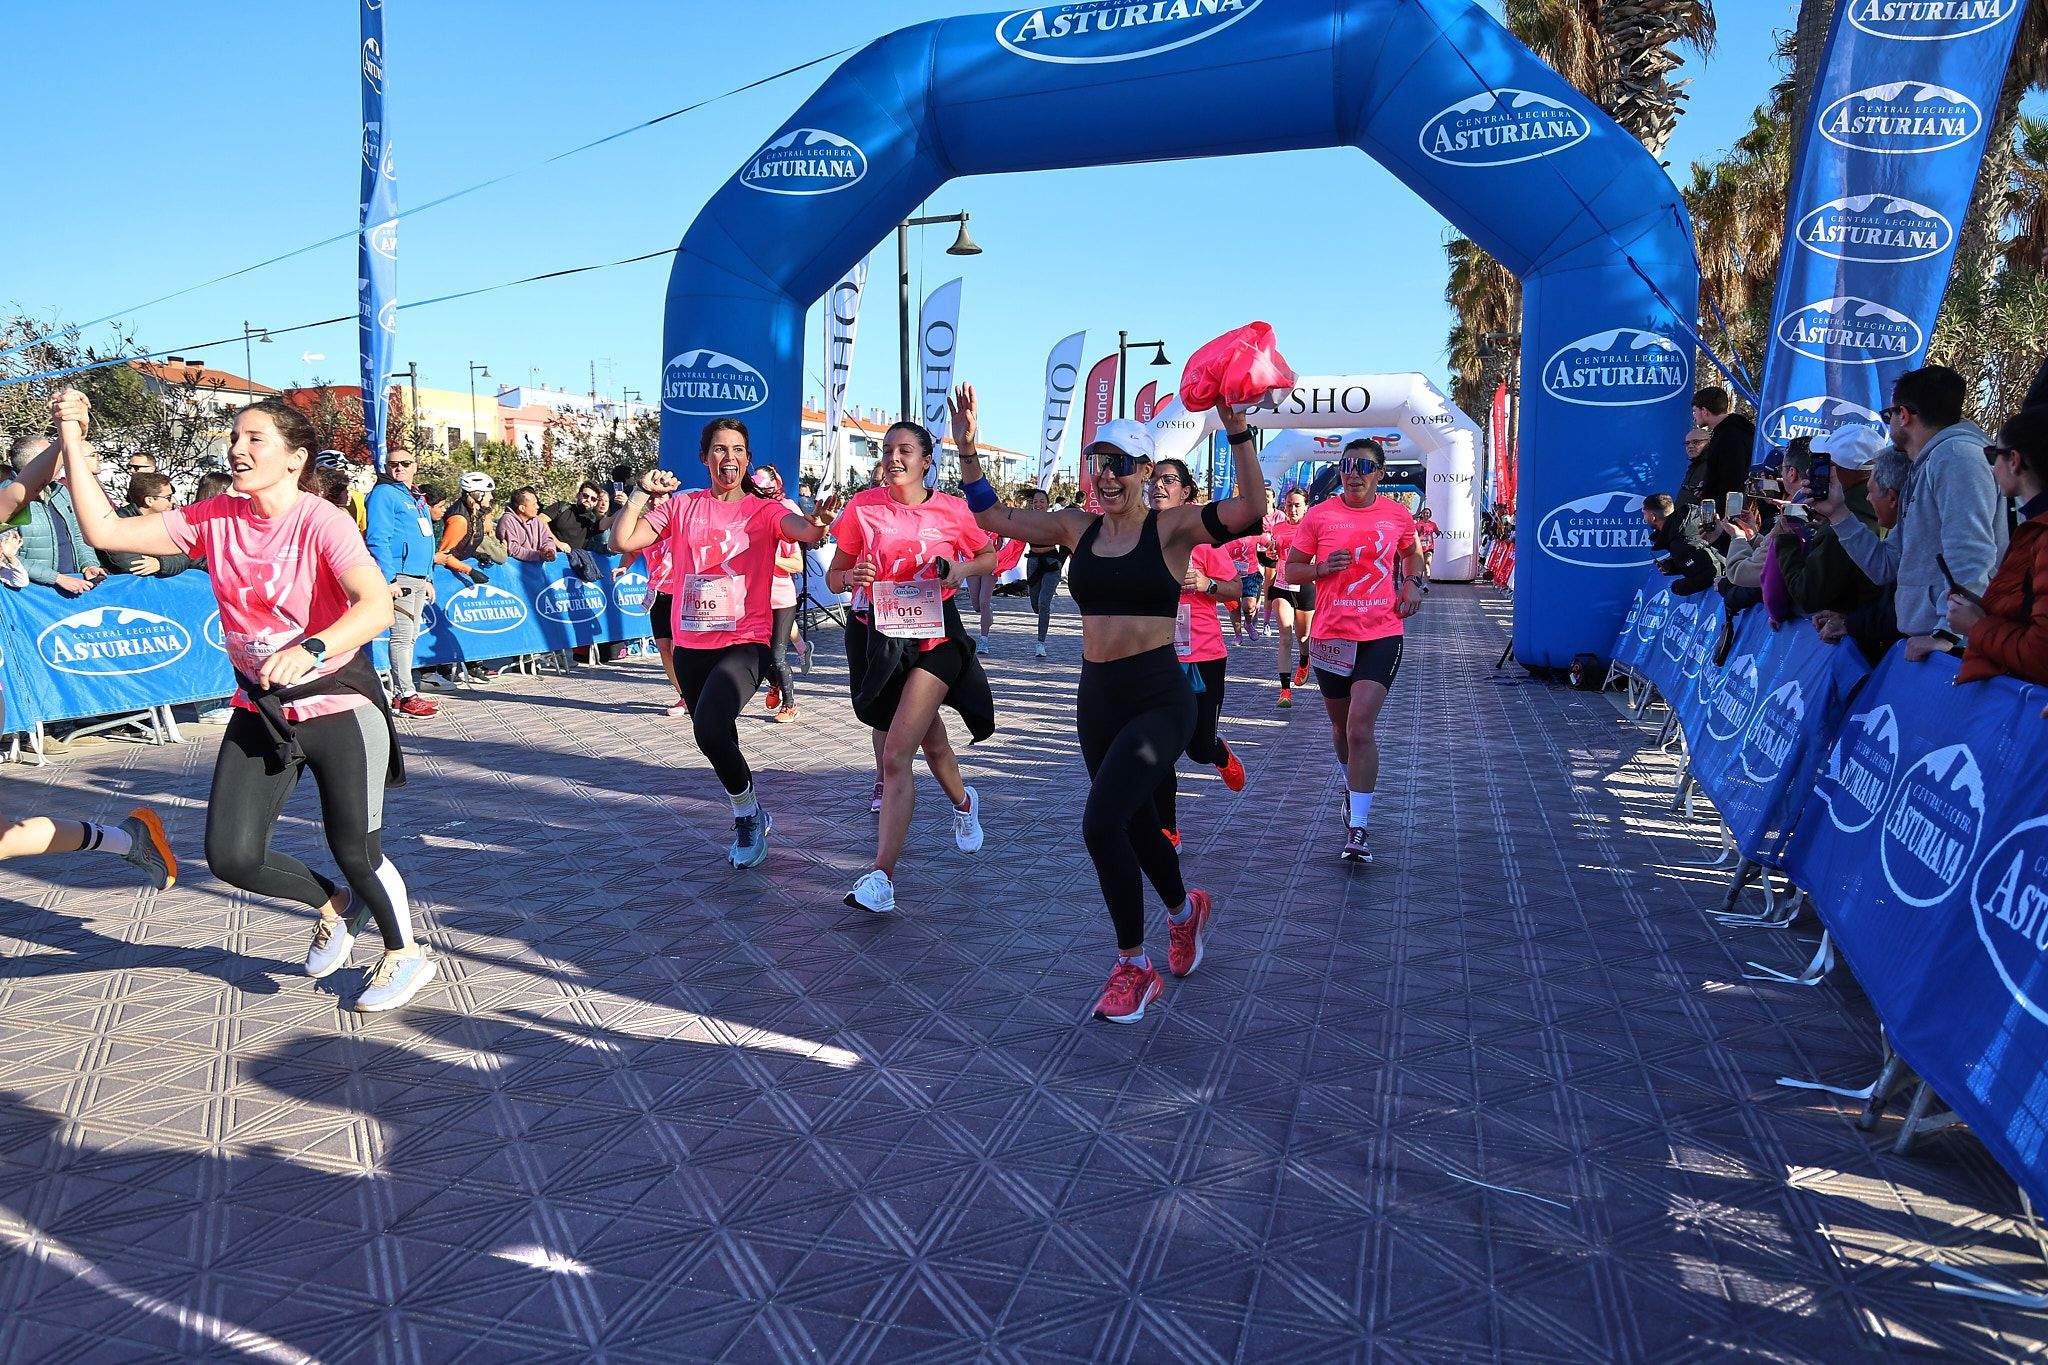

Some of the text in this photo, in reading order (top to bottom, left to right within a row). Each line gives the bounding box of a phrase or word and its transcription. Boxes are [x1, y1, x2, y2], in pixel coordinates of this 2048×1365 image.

[1858, 0, 2001, 21] ASTURIANA
[1013, 0, 1245, 43] ASTURIANA
[1456, 110, 1571, 127] CENTRAL LECHERA
[1858, 105, 1966, 114] CENTRAL LECHERA
[1827, 106, 1967, 136] ASTURIANA
[1432, 121, 1580, 154] ASTURIANA
[766, 149, 852, 160] CENTRAL LECHERA
[745, 158, 858, 180] ASTURIANA
[1830, 215, 1938, 229] CENTRAL LECHERA
[1806, 216, 1938, 249] ASTURIANA
[1787, 317, 1907, 353] ASTURIANA
[1812, 317, 1908, 333] CENTRAL LECHERA
[1575, 355, 1630, 365] CENTRAL
[710, 373, 755, 382] LECHERA
[1551, 360, 1682, 390] ASTURIANA
[663, 374, 759, 402] ASTURIANA
[1093, 378, 1109, 433] tander
[1246, 386, 1371, 415] SHO
[1156, 420, 1195, 429] OYSHO
[1411, 415, 1454, 425] OYSHO
[1569, 517, 1623, 526] CENTRAL
[1546, 520, 1655, 548] ASTURIA
[453, 603, 522, 623] ASTURIANA
[544, 595, 603, 615] ASTURIANA
[694, 600, 717, 610] 016
[897, 606, 922, 616] 016
[73, 625, 172, 640] CENTRAL LECHERA
[52, 635, 184, 664] ASTURIANA
[1886, 781, 1965, 886] ASTURIANA
